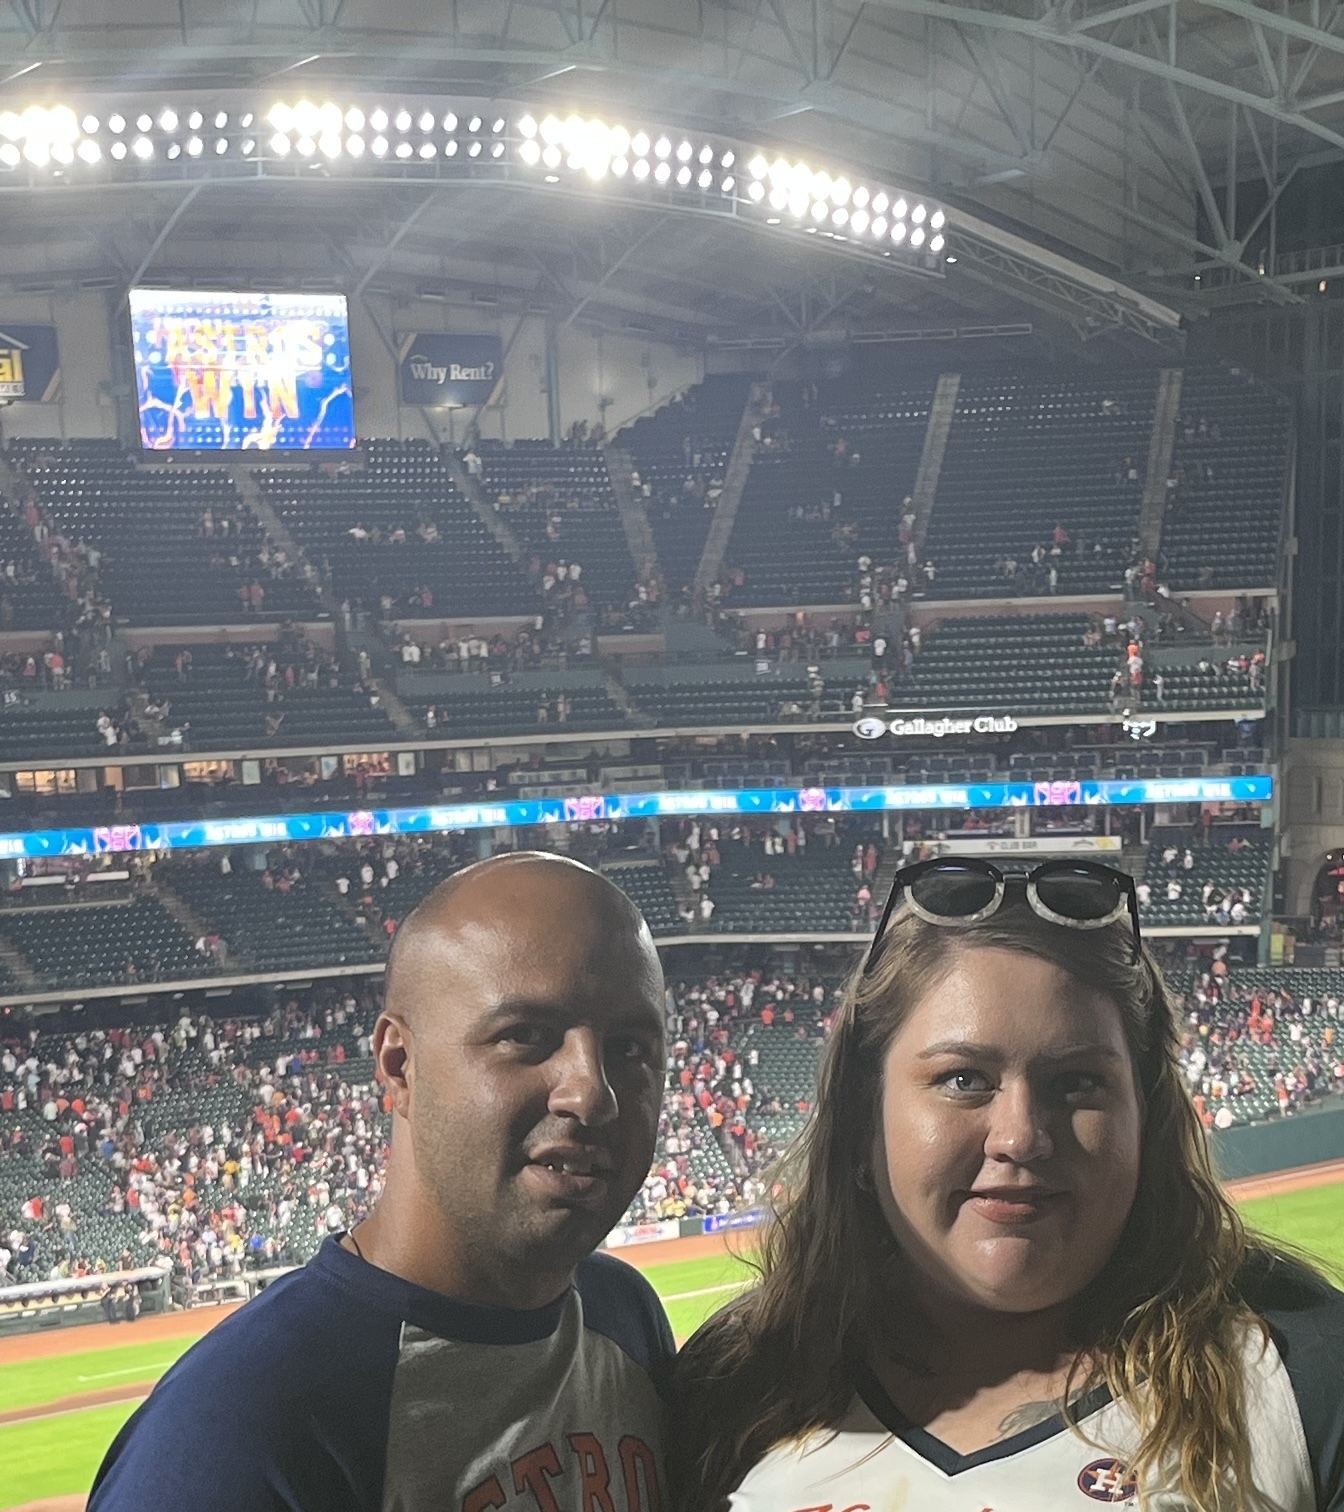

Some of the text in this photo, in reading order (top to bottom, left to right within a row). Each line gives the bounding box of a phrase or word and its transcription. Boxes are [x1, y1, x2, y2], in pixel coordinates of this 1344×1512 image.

[410, 361, 494, 384] Why Rent?
[186, 368, 298, 418] WIN
[890, 718, 973, 737] Gallagher
[974, 716, 1017, 733] Club
